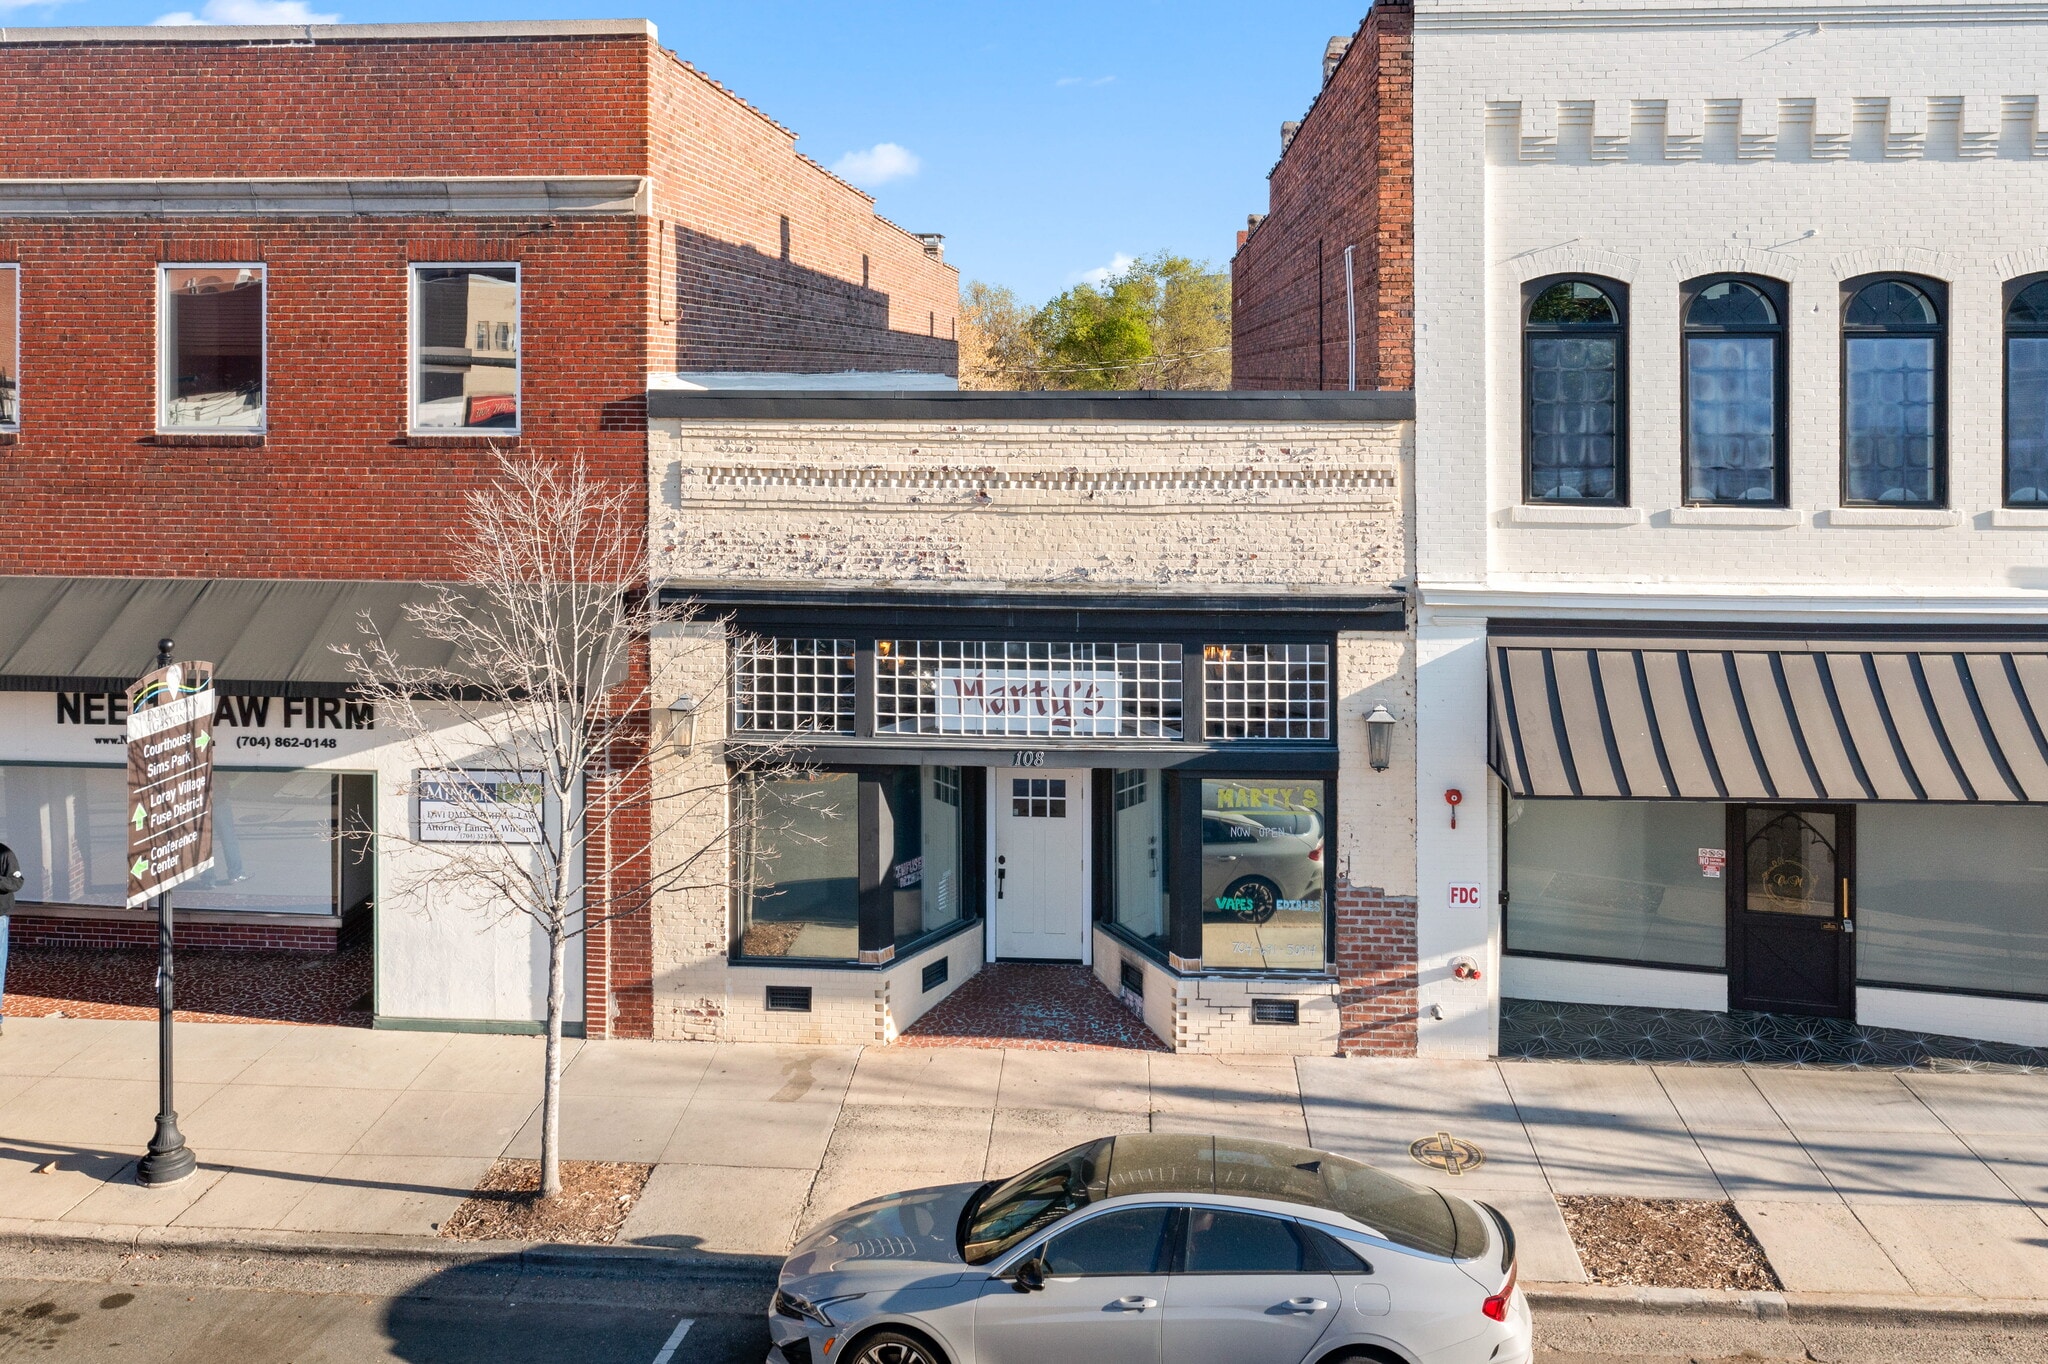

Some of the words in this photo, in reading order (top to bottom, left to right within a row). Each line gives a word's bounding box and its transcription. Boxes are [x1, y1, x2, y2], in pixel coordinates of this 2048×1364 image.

[953, 672, 1104, 728] Marty's
[213, 695, 270, 728] AW
[284, 697, 374, 730] FIRM
[143, 732, 191, 758] Courthouse
[236, 736, 271, 749] (704)
[275, 737, 337, 749] 862-0148
[147, 760, 170, 778] Sims
[171, 751, 191, 769] Park
[1014, 751, 1044, 767] 108
[150, 788, 176, 807] Loray
[178, 776, 206, 796] Village
[1217, 786, 1318, 809] MARTY'S
[150, 811, 172, 828] Fuse
[173, 793, 203, 818] District
[1230, 827, 1251, 838] NOW
[150, 831, 198, 860] Conference
[150, 854, 180, 876] Center
[1215, 897, 1253, 911] VAPES
[1276, 899, 1321, 912] EDIBLES
[1450, 887, 1479, 904] FDC
